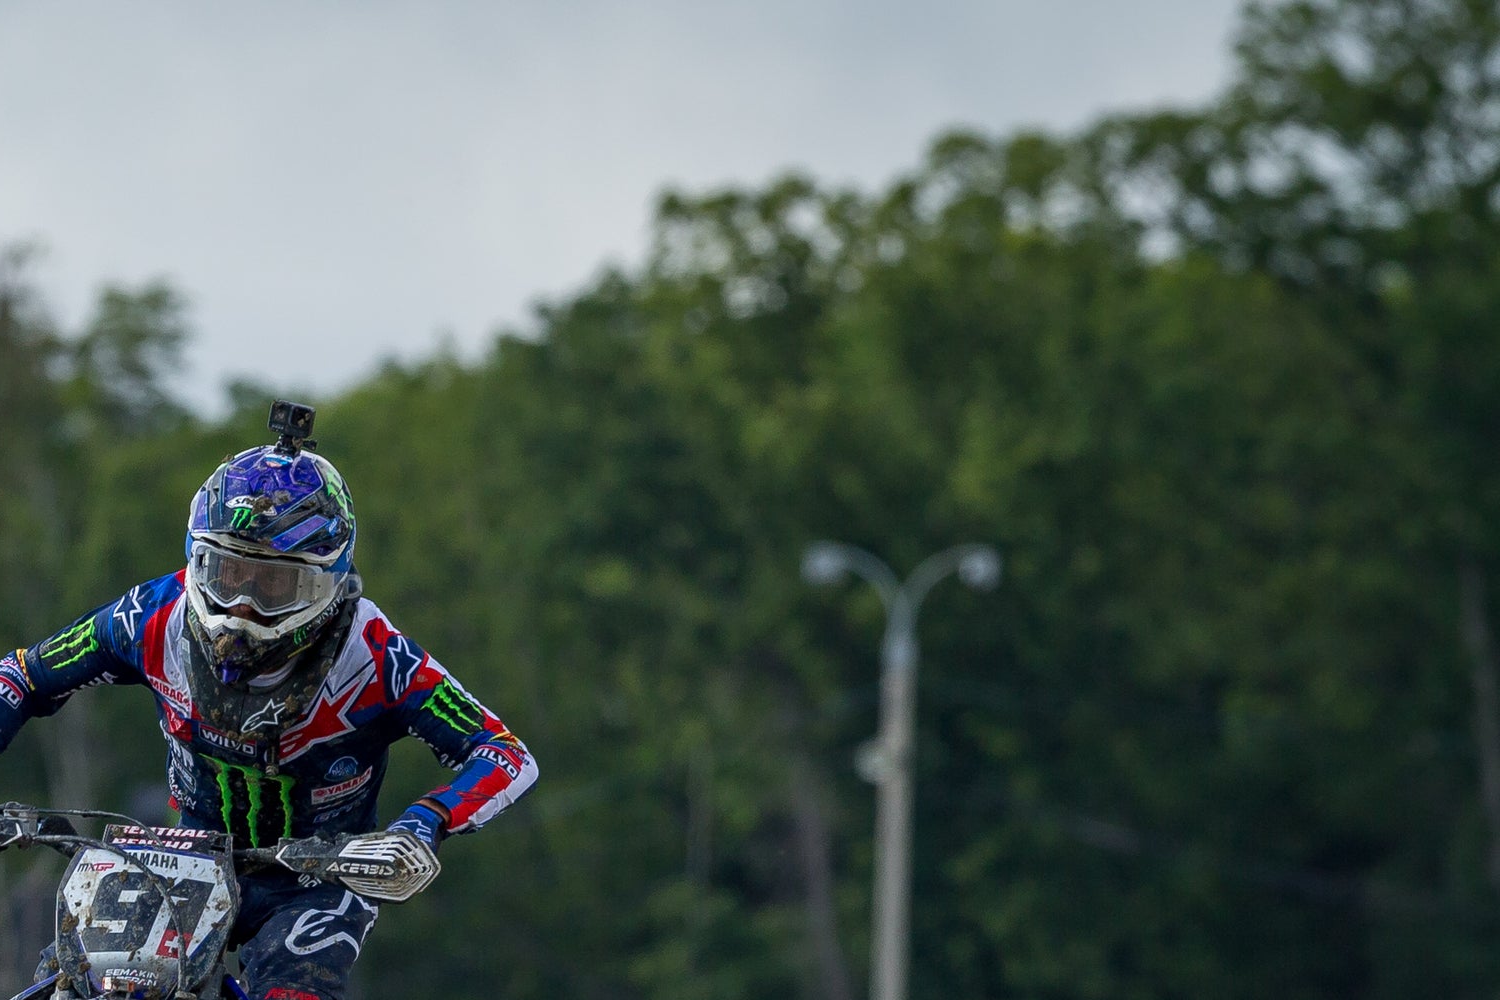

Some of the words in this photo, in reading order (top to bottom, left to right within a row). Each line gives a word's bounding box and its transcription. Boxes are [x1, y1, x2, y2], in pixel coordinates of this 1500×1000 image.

[201, 728, 255, 754] WILVO
[325, 861, 395, 876] ACERBIS
[105, 968, 159, 979] SEMAKIN
